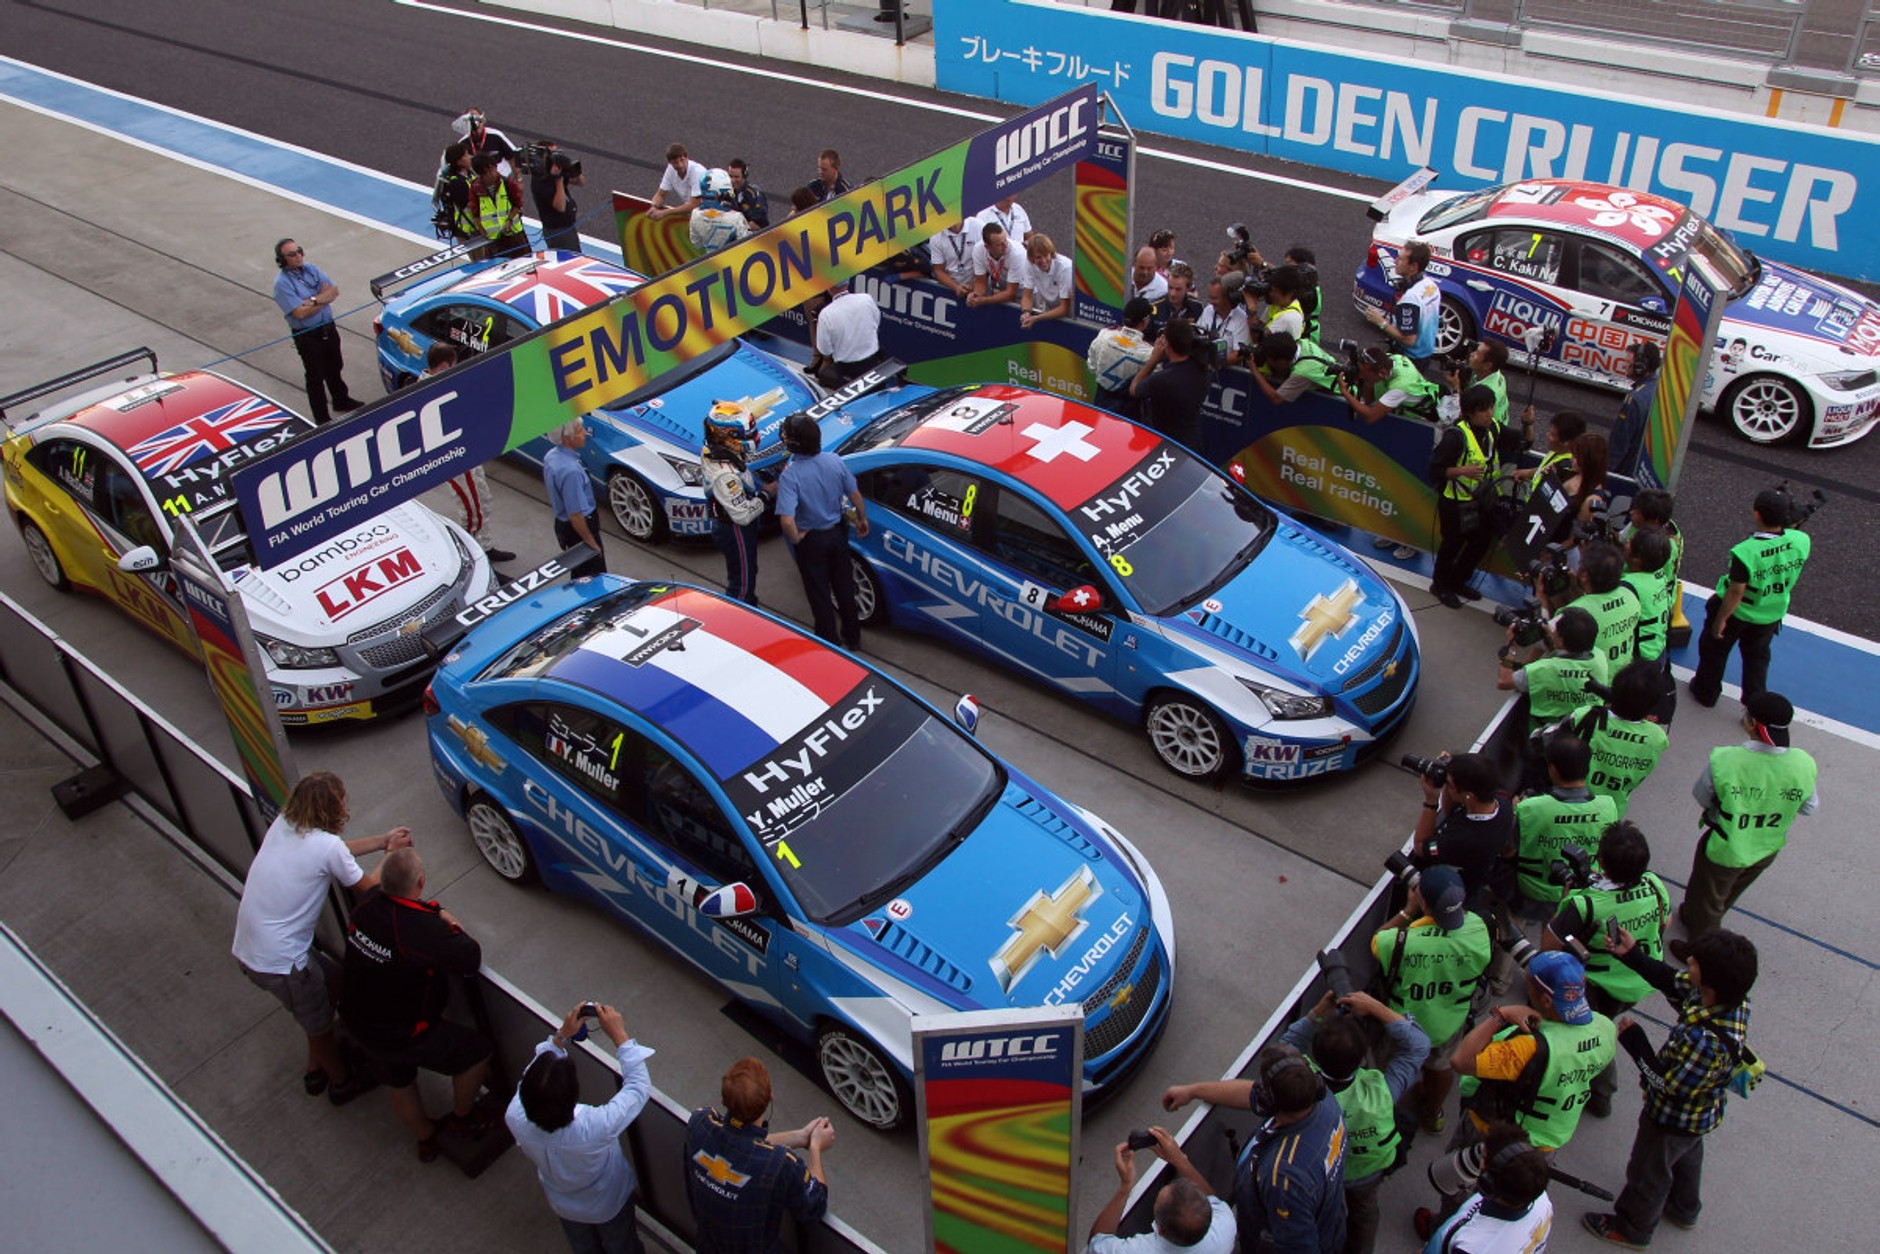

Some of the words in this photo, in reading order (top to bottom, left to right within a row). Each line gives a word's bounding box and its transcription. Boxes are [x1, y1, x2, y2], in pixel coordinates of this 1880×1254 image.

[960, 36, 1131, 88] ブレーキフルード
[995, 97, 1088, 175] WTCC
[1098, 142, 1123, 158] TCC
[1151, 51, 1438, 167] GOLDEN
[1453, 105, 1858, 252] CRUISER
[1527, 233, 1543, 259] 7
[1653, 215, 1700, 259] HyFlex
[394, 244, 468, 278] CRUZE
[1509, 259, 1539, 277] Kaki
[548, 230, 813, 404] EMOTION
[827, 168, 947, 267] PARK
[854, 274, 957, 329] WTCC
[779, 309, 808, 326] ing.
[1494, 293, 1563, 332] LIQUI
[1599, 303, 1610, 315] 7
[1626, 312, 1672, 331] YOKOHAMA
[806, 371, 887, 419] CRUZE
[1007, 360, 1042, 383] Real
[1046, 373, 1088, 398] cars.
[72, 446, 86, 480] 11
[164, 424, 297, 489] HyFlex
[258, 390, 463, 531] WTCC
[1282, 446, 1326, 473] Real
[1331, 461, 1382, 490] cars.
[268, 531, 290, 549] FIA
[290, 512, 325, 536] World
[326, 491, 369, 519] Touring
[370, 482, 389, 498] Car
[392, 446, 467, 488] Championship
[962, 484, 977, 517] 8
[1080, 450, 1176, 522] HyFlex
[1280, 463, 1324, 491] Real
[1329, 482, 1399, 517] racing.
[162, 493, 193, 517] 11
[672, 504, 706, 518] KW
[907, 493, 921, 510] A.
[923, 499, 959, 525] Menu
[670, 519, 713, 534] CRU
[1091, 533, 1111, 549] A.
[1105, 513, 1144, 539] Menu
[277, 524, 391, 583] bamboo
[1110, 554, 1134, 577] 8
[316, 549, 423, 619] LKM
[455, 560, 568, 627] CRUZE
[883, 530, 1107, 668] CHEVROLET
[1026, 587, 1040, 604] 8
[1332, 611, 1395, 676] CHEVROLET
[306, 684, 349, 703] KW
[610, 732, 624, 771] 1
[743, 688, 885, 793] HyFlex
[1253, 744, 1299, 761] KW
[562, 743, 573, 764] Y.
[575, 751, 620, 791] Muller
[1246, 754, 1345, 780] CRUZE
[1591, 748, 1653, 771] HOTOGRAPHER
[746, 810, 773, 830] Y.
[767, 776, 827, 816] Muller
[1554, 813, 1600, 824] WTCC
[1738, 813, 1783, 829] 012
[776, 840, 802, 869] 1
[523, 778, 768, 977] CHEVROLET
[677, 878, 687, 895] 1
[725, 919, 763, 946] HAMA
[1042, 912, 1135, 1007] CHEVROLET
[1409, 981, 1453, 1001] 006
[941, 1034, 1060, 1061] WTCC
